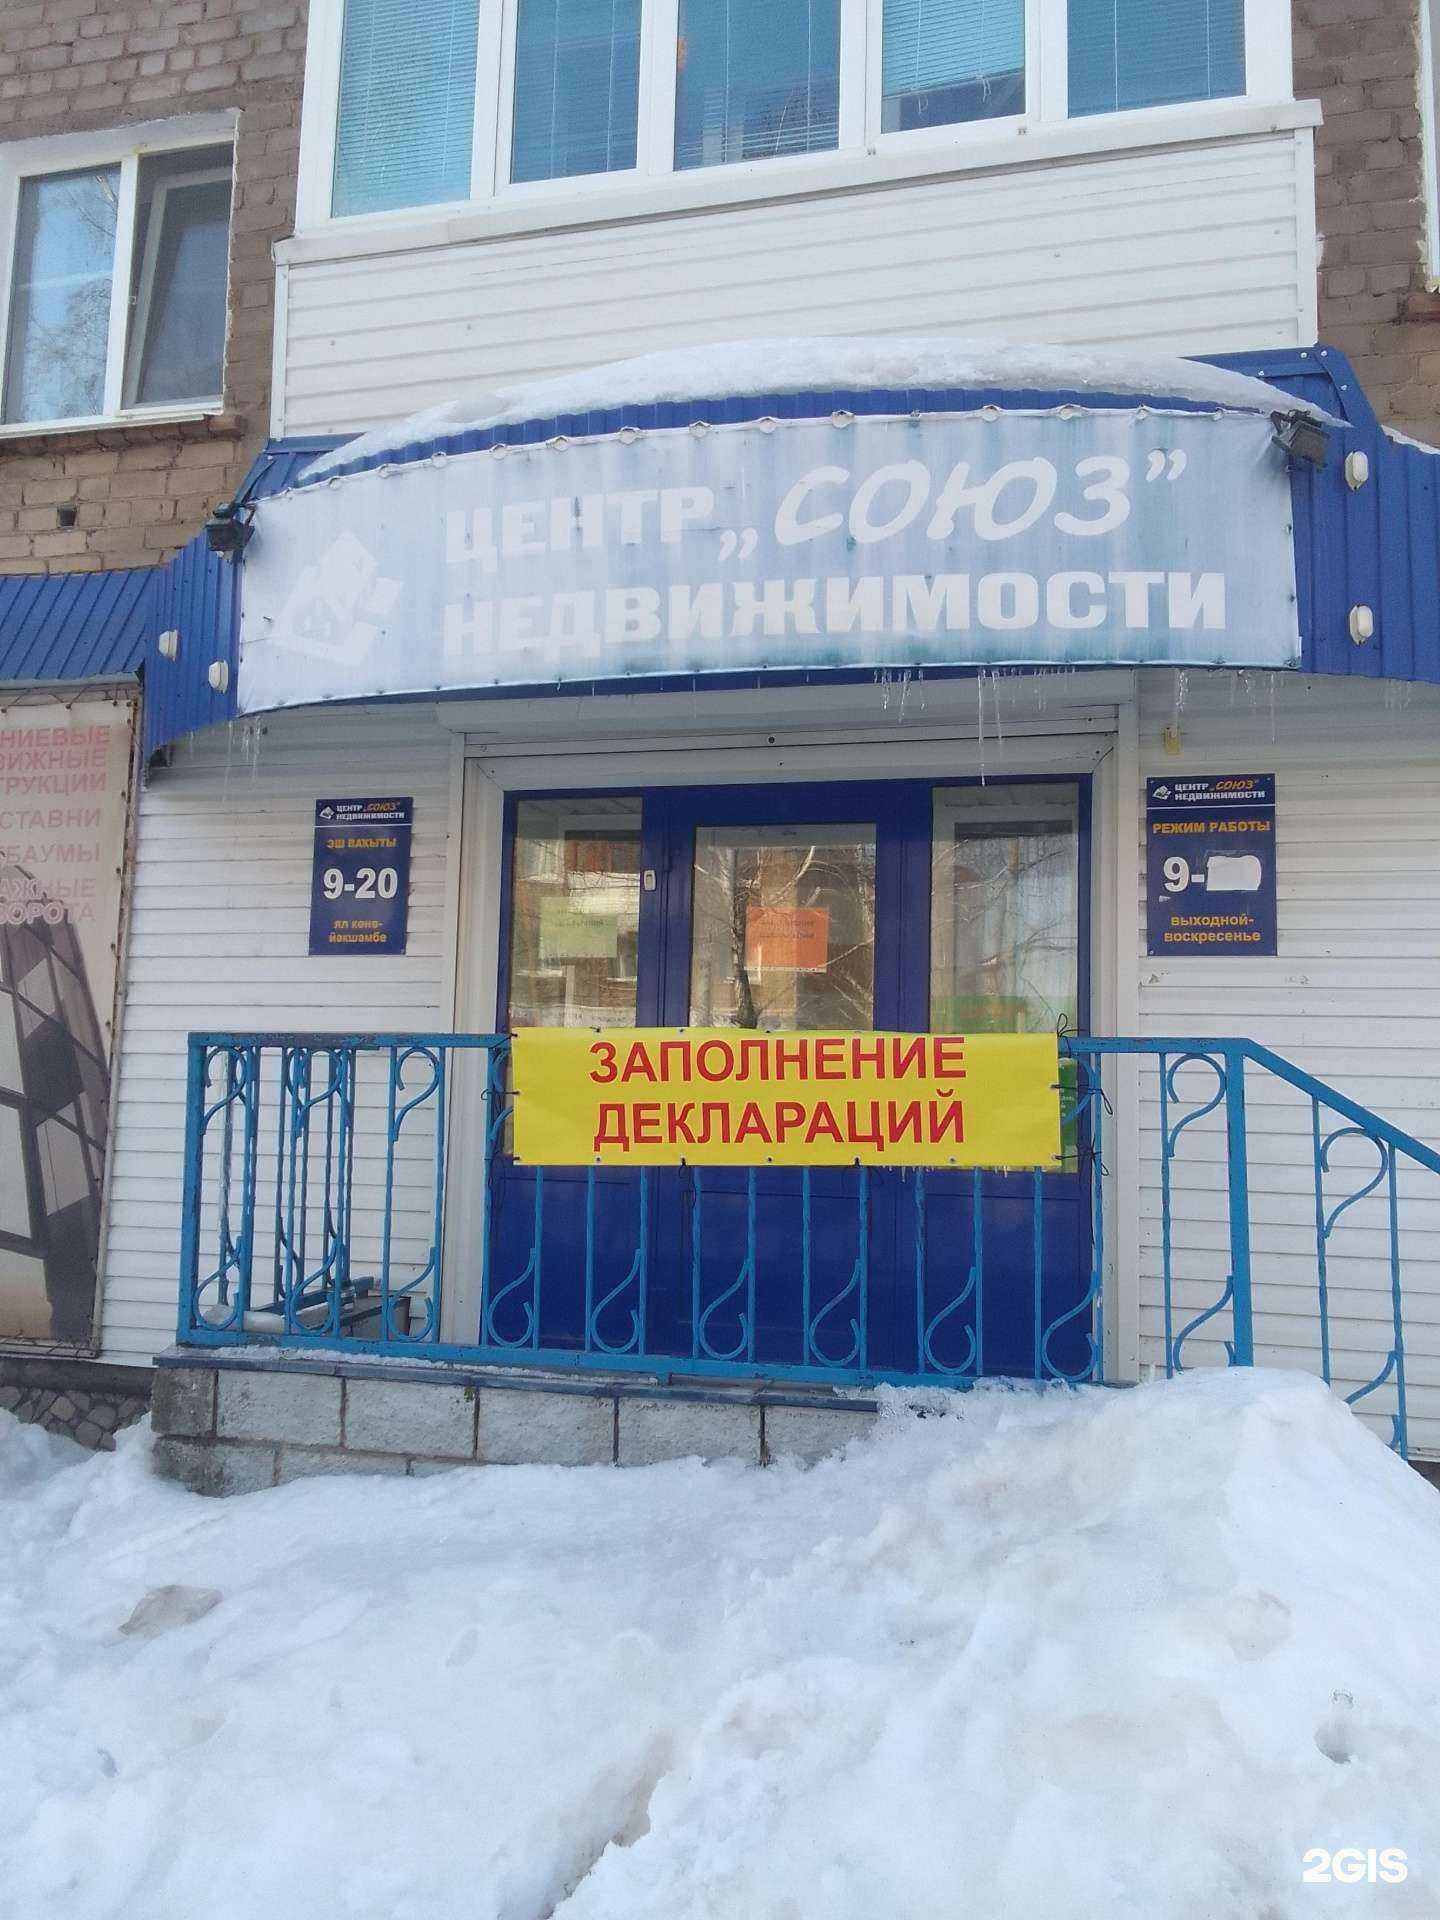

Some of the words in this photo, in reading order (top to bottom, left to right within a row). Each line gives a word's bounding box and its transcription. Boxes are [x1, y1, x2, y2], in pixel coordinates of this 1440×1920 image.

[445, 486, 715, 573] ЦЕНТР
[443, 572, 1226, 661] НЕДВИЖИМОСТИ
[1174, 783, 1209, 792] ЦЕНТР
[1174, 790, 1266, 802] НЕДВИЖИМОСТИ
[1152, 822, 1206, 834] РЕЖИМ
[1209, 820, 1271, 833] РАБОТЫ
[323, 867, 398, 900] 9-20
[589, 1037, 967, 1083] ЗАПОЛНЕНИЕ
[593, 1089, 965, 1152] ДЕКЛАРАЦИЙ
